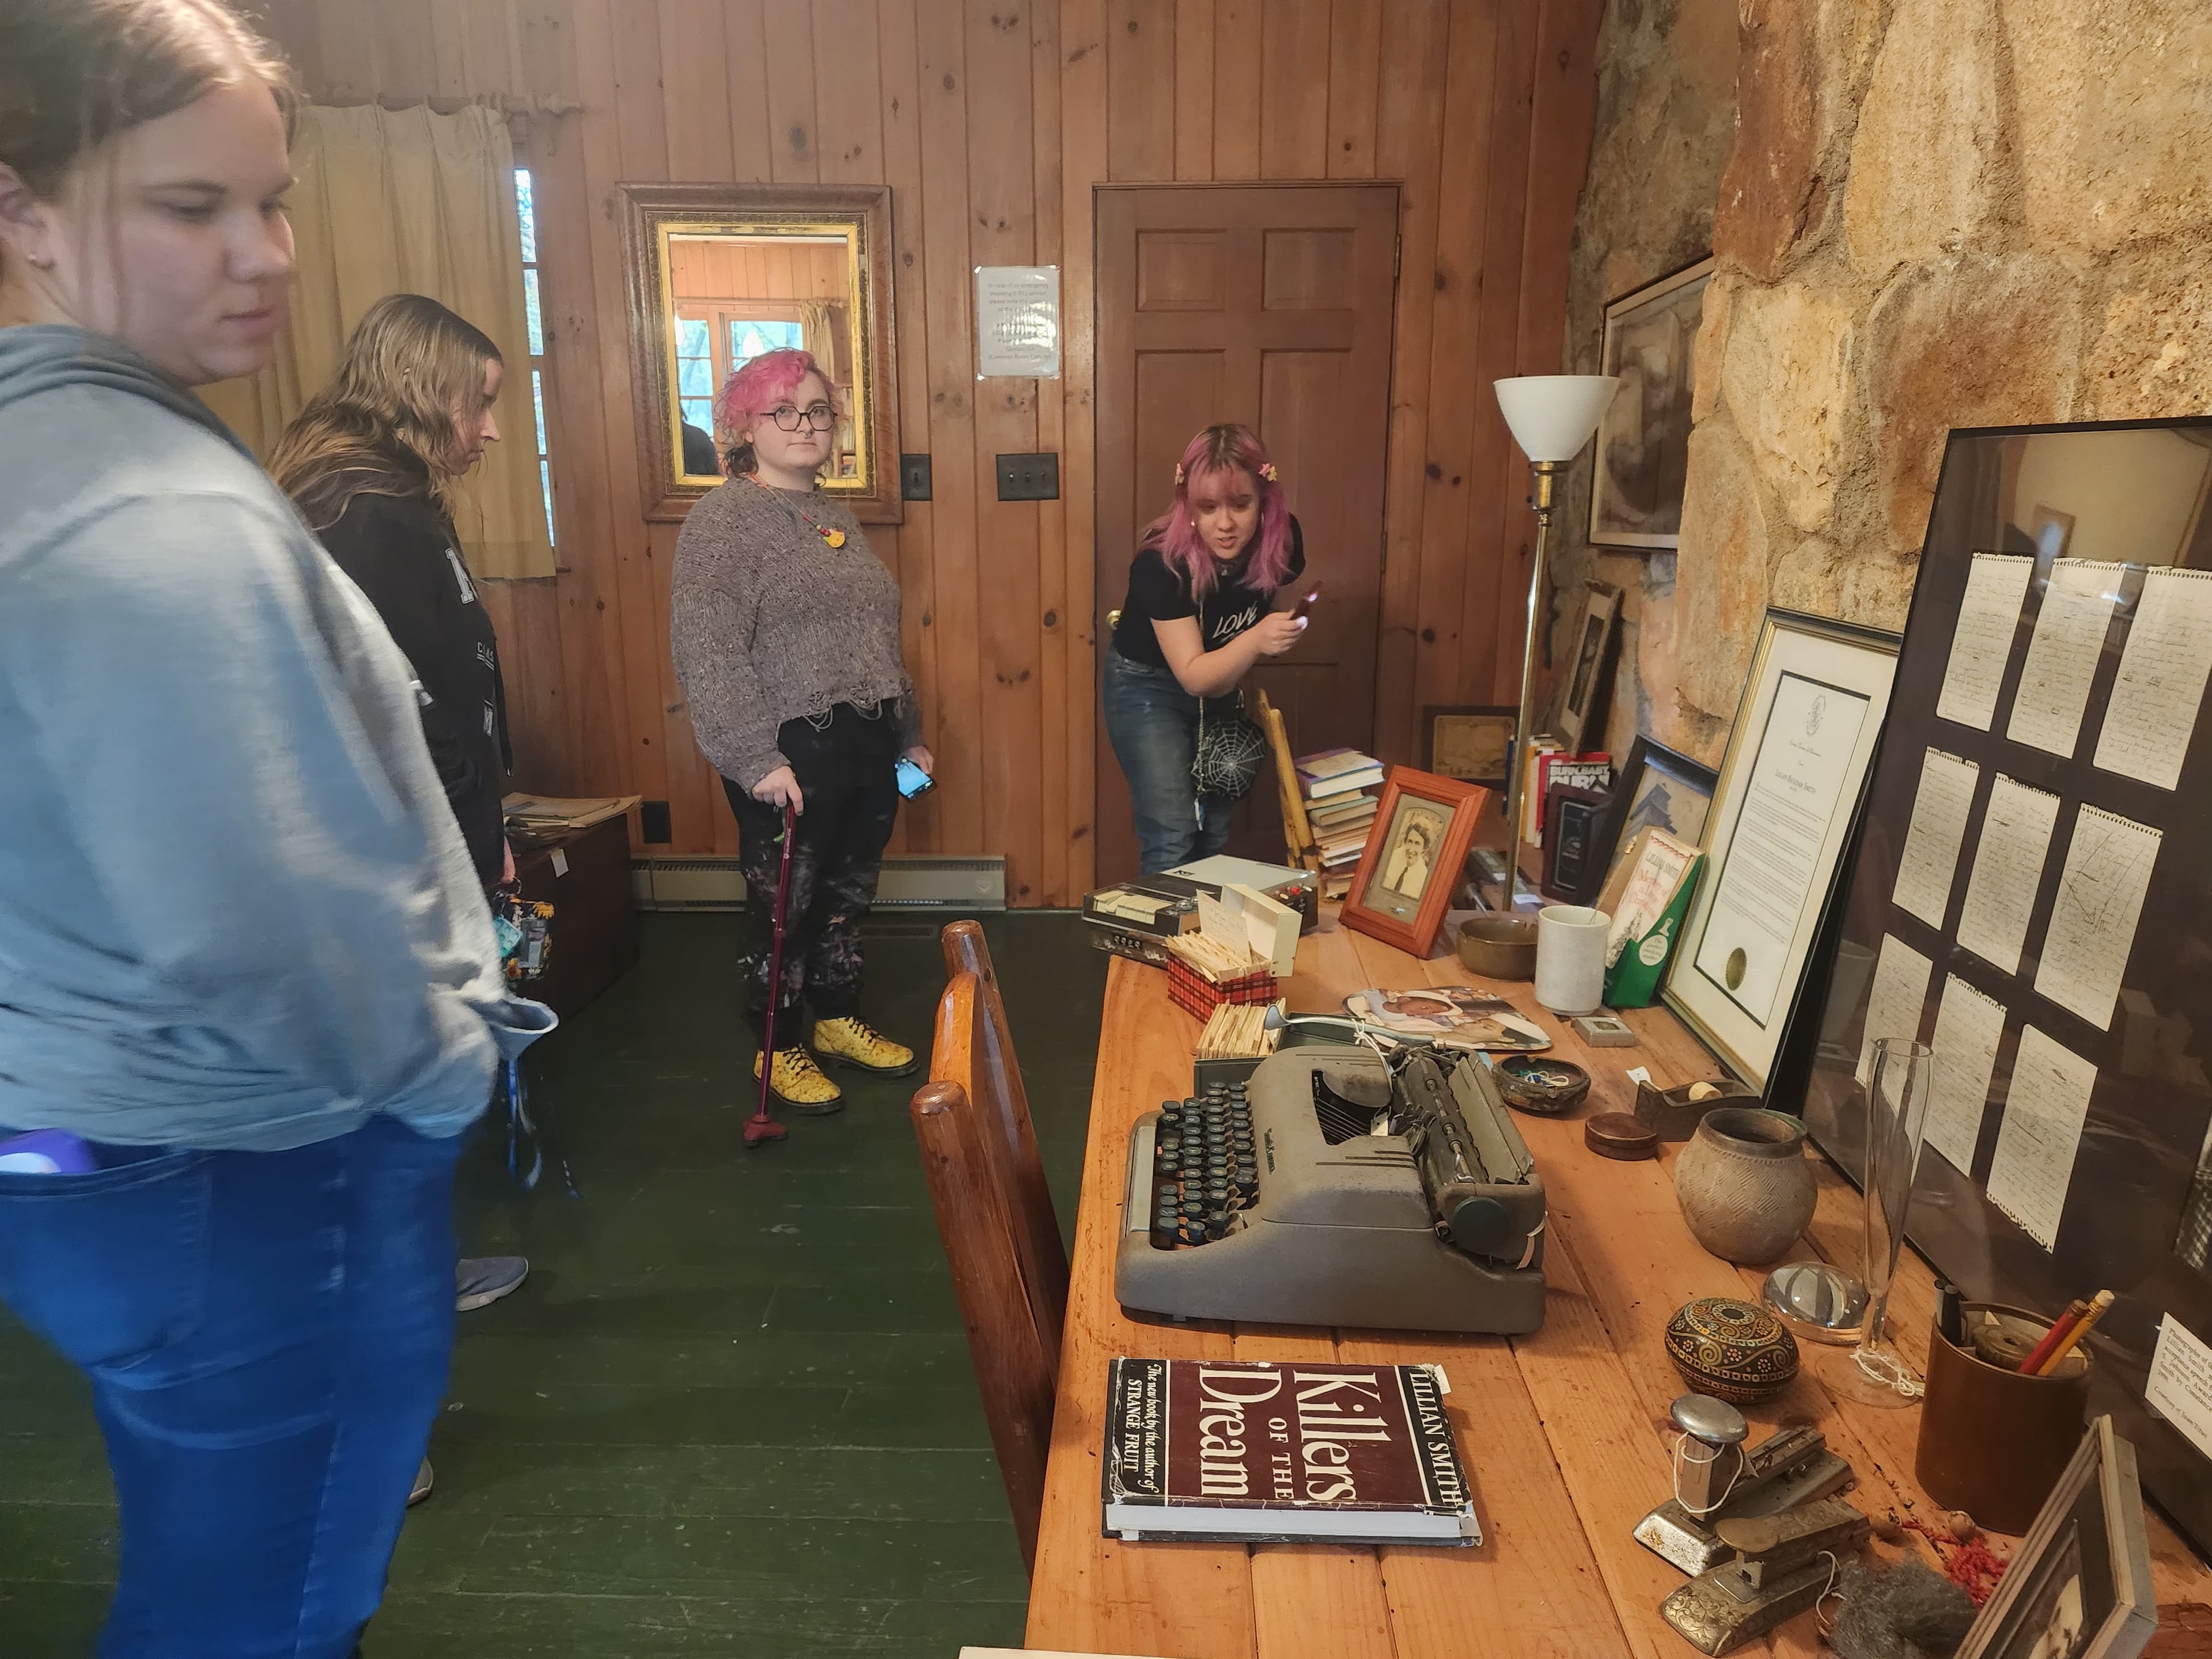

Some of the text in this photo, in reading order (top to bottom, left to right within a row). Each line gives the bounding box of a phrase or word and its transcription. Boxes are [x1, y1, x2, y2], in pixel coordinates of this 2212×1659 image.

[2161, 1361, 2175, 1378] Smith
[2165, 1346, 2208, 1387] acceptance speech
[2166, 1336, 2205, 1373] Lillian Smith
[2169, 1359, 2190, 1382] Johnson
[2170, 1328, 2200, 1358] Photographs
[2201, 1357, 2209, 1365] of
[1124, 1378, 1143, 1472] STRANGE FRUIT
[1137, 1363, 1162, 1493] The new book by the author of
[1199, 1366, 1282, 1495] Dream
[2154, 1386, 2175, 1410] Courtesy
[2176, 1407, 2182, 1415] of
[1268, 1417, 1294, 1499] OF THE
[1293, 1369, 1392, 1501] Killers
[1410, 1372, 1465, 1508] LILLIAN SMITH
